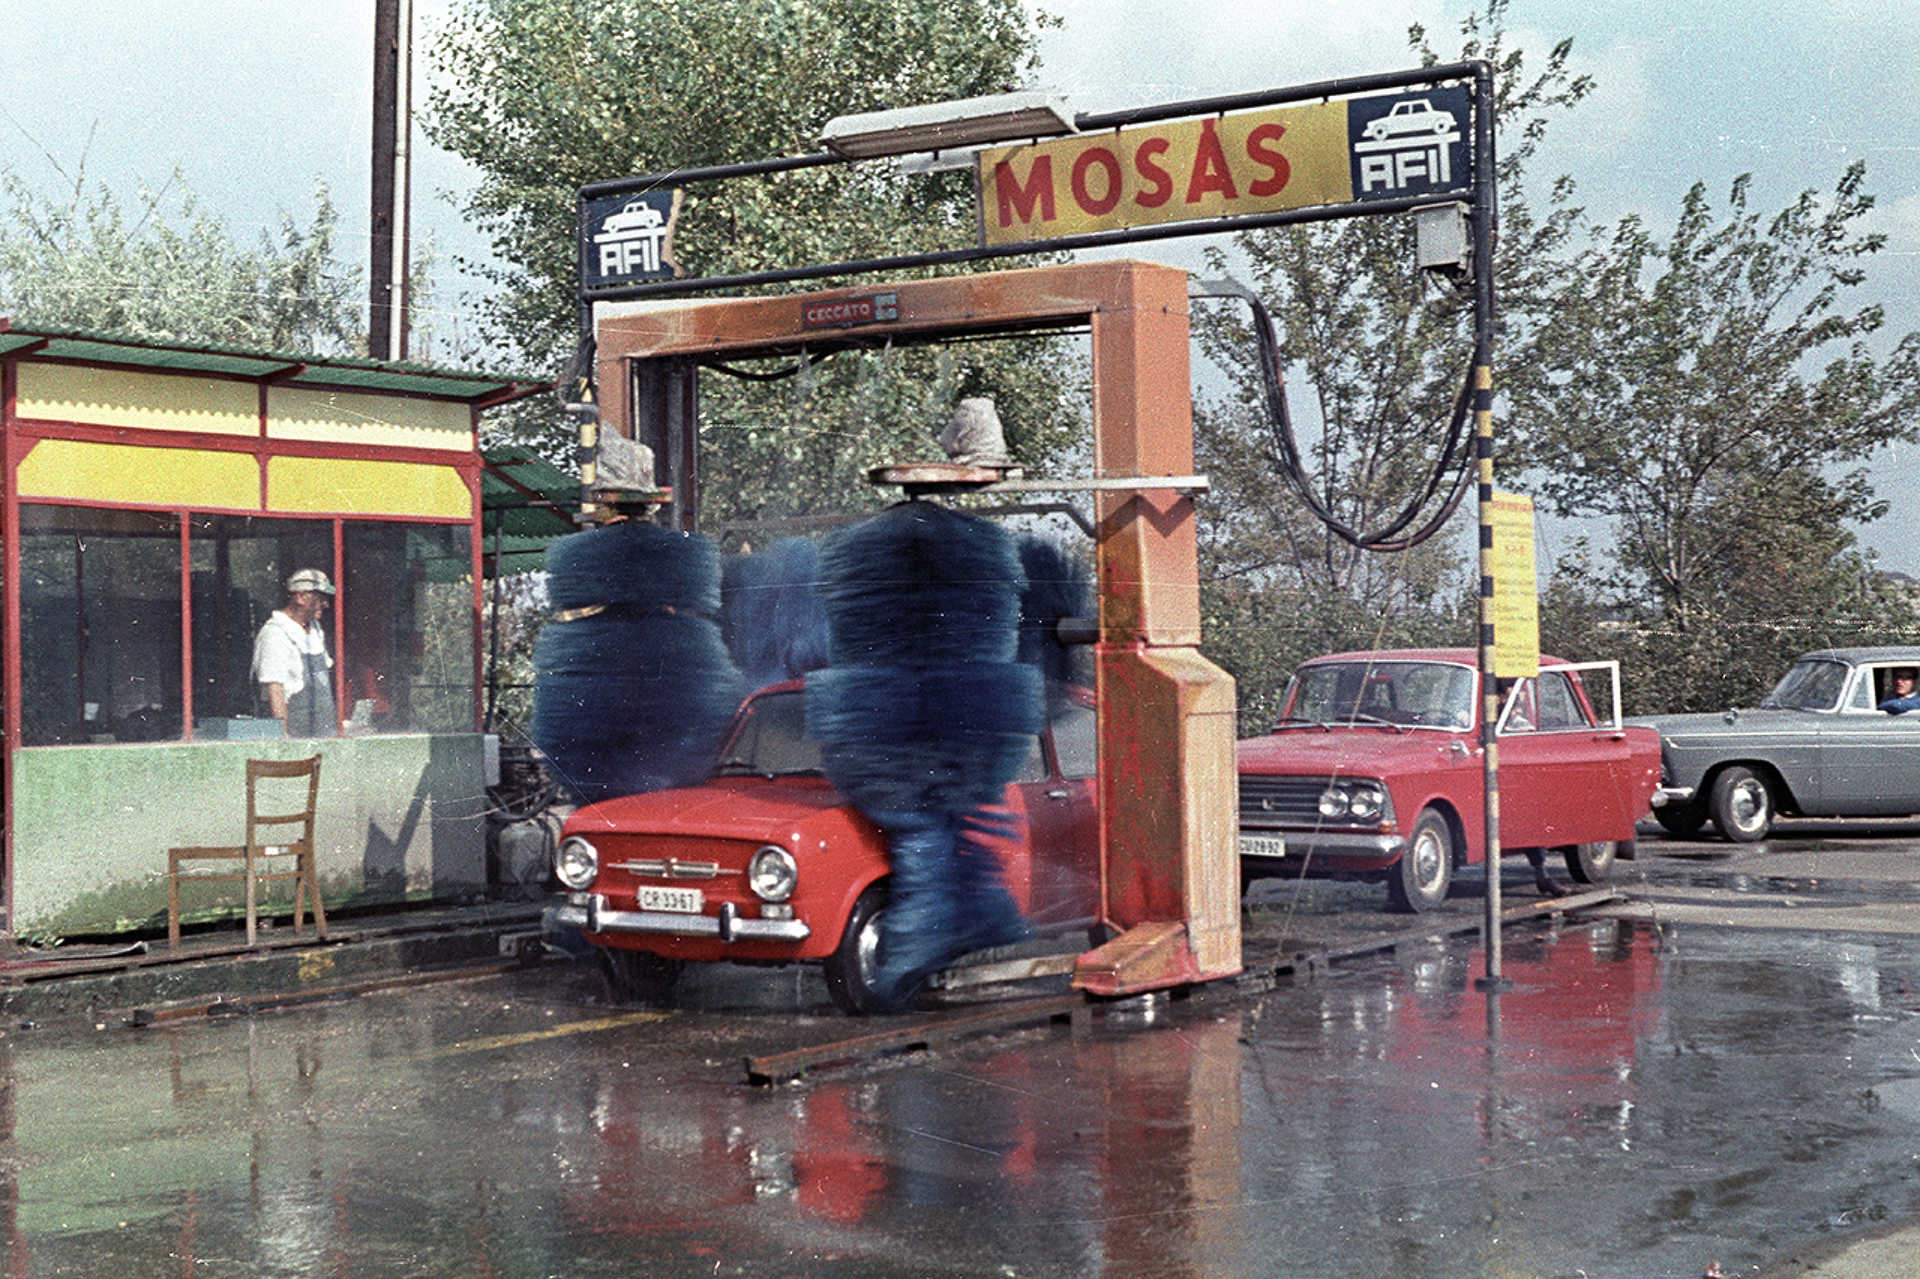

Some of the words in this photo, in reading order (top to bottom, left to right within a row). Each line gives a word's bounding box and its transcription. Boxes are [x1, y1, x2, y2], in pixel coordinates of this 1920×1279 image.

[995, 118, 1292, 228] MOSÁS
[1357, 137, 1454, 192] AFIT
[597, 232, 662, 277] AFIT
[807, 303, 871, 322] CECCATO
